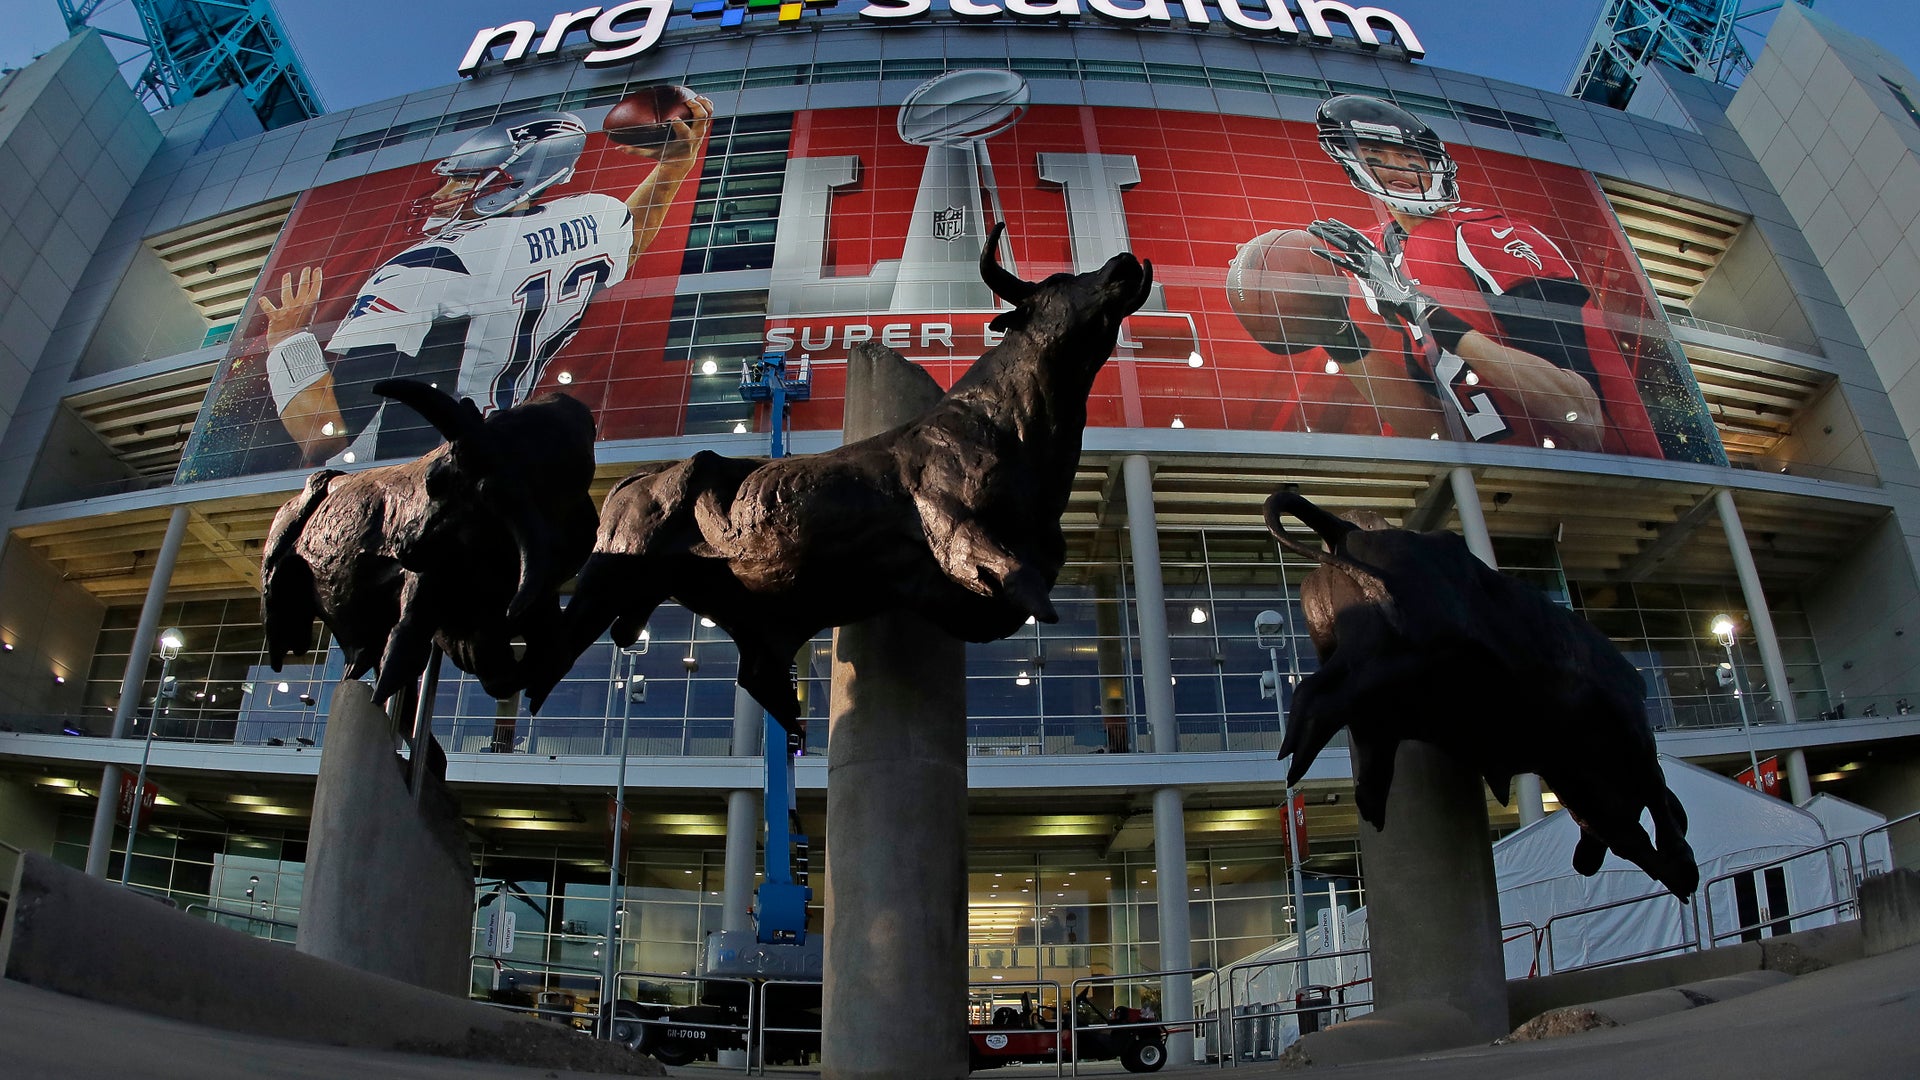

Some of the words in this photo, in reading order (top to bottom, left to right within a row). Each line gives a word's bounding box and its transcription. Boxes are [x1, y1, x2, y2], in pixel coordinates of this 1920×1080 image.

[457, 0, 673, 75] nrg
[523, 214, 598, 264] BRADY
[937, 220, 960, 237] NFL
[482, 253, 614, 418] 12
[765, 322, 955, 353] SUPER
